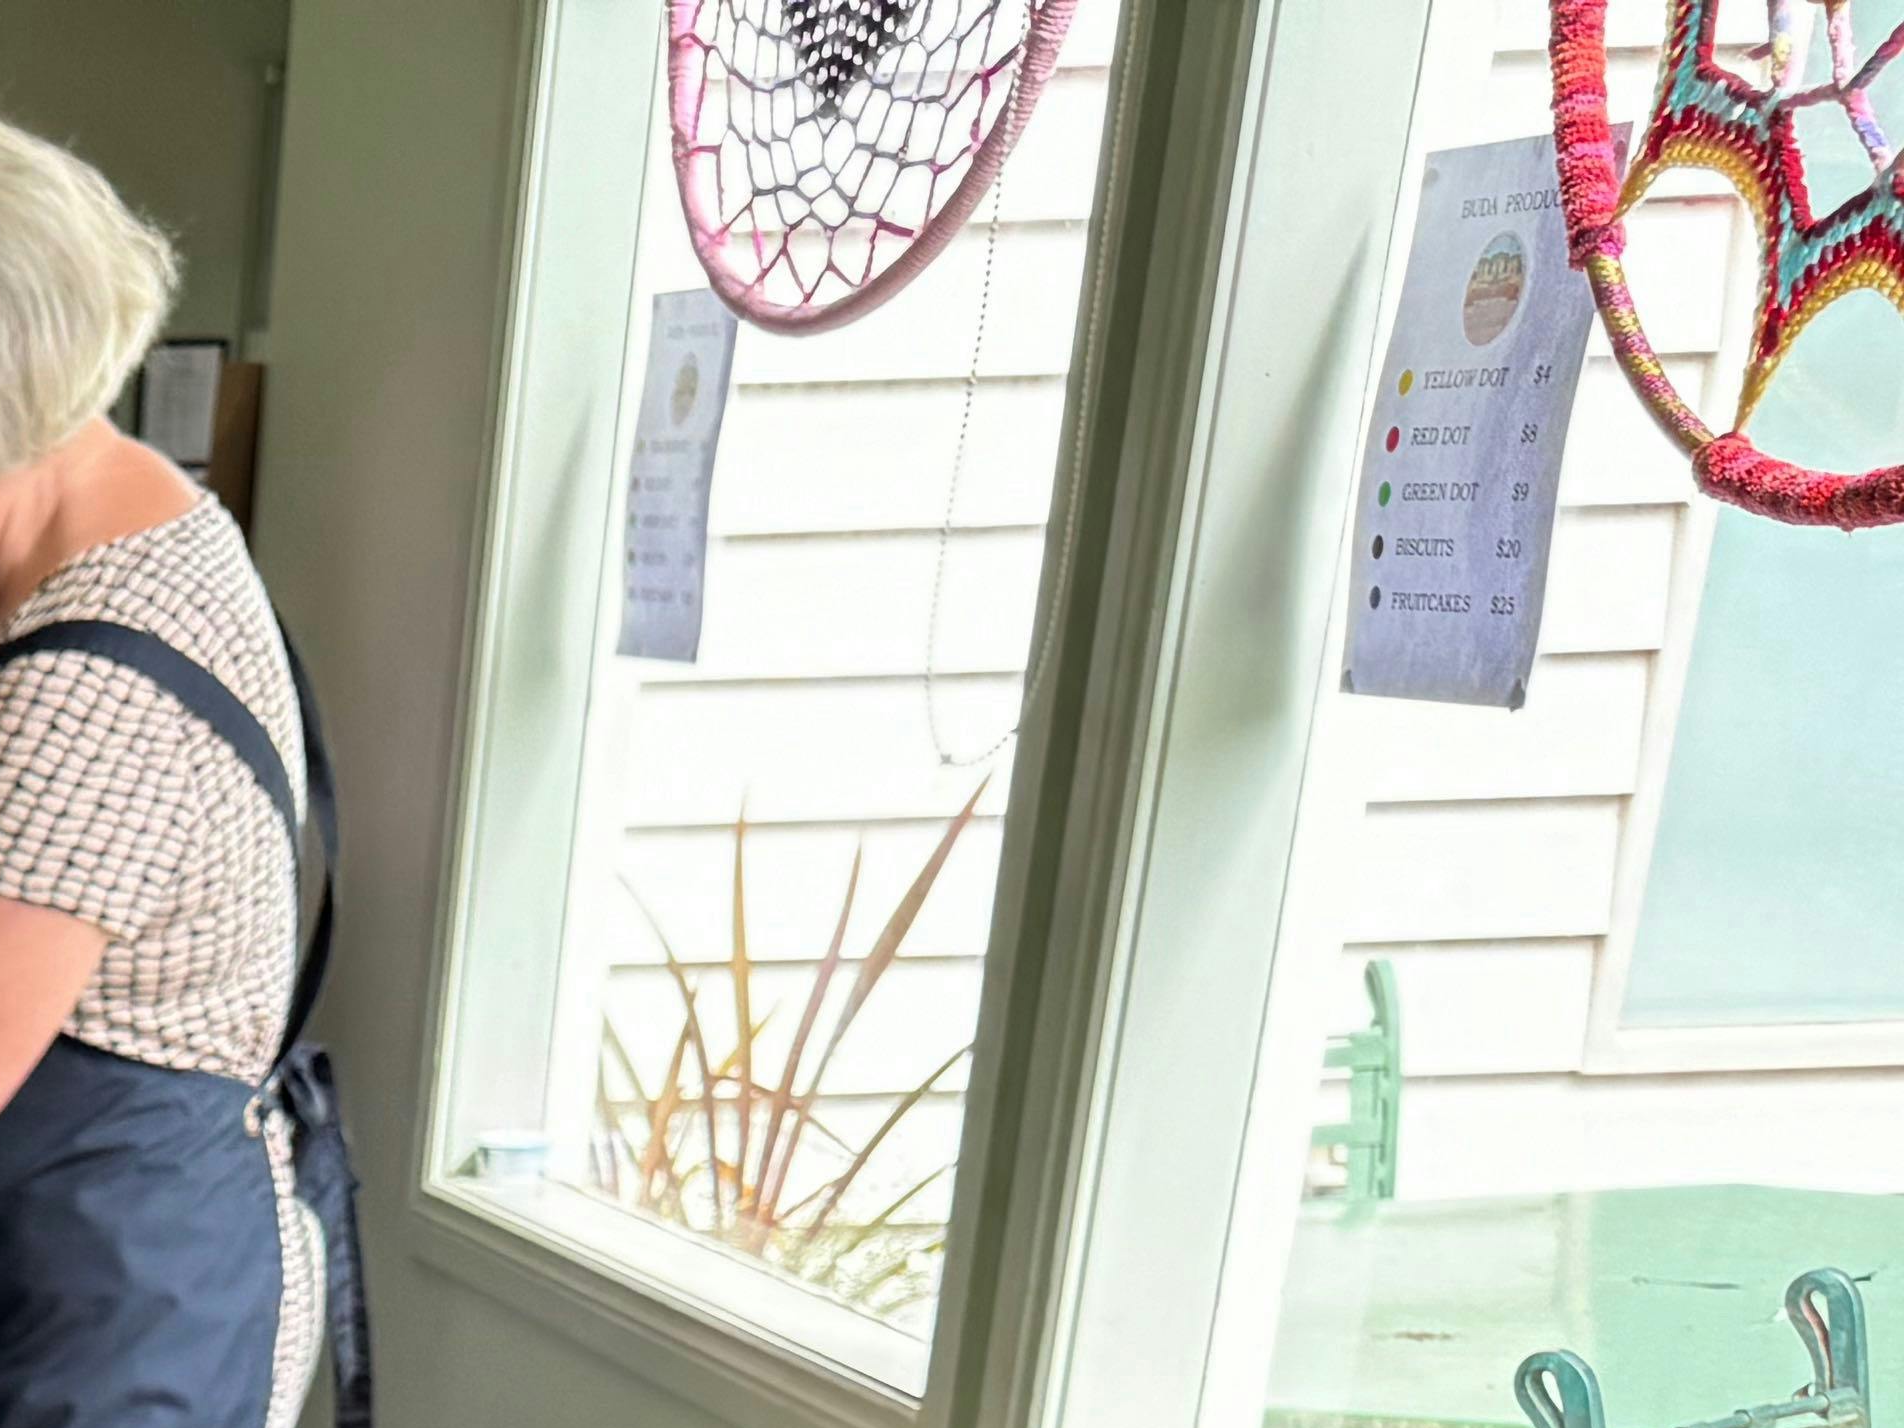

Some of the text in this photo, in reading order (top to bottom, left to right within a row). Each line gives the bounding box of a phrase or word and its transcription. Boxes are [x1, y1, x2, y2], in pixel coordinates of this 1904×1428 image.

[1505, 189, 1563, 214] PRODUC
[1423, 364, 1552, 390] YELLOW DOT $4
[1410, 427, 1440, 446] RED
[1441, 425, 1472, 446] DOT
[1402, 482, 1529, 501] GREEN DOT $9
[1395, 537, 1521, 559] BISCUITS $20
[1391, 592, 1515, 615] FRUITCAKES $25
